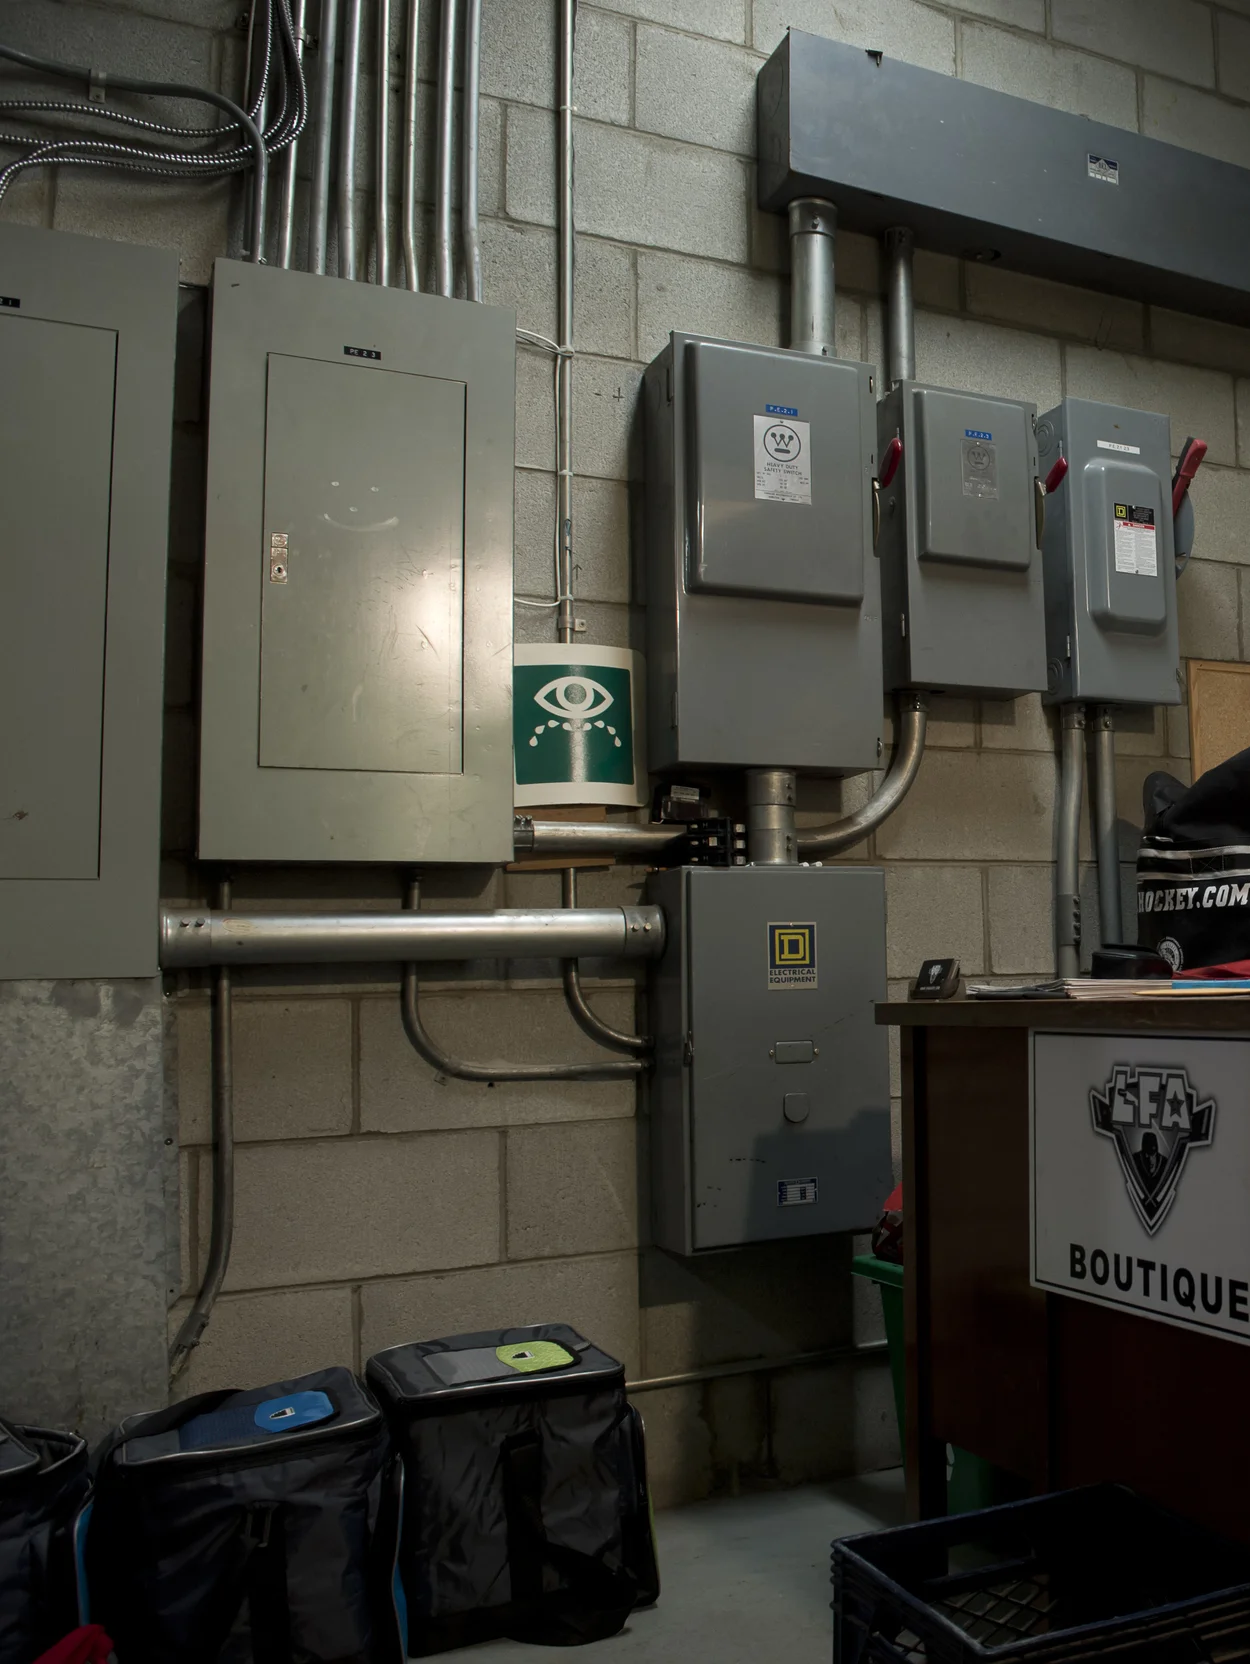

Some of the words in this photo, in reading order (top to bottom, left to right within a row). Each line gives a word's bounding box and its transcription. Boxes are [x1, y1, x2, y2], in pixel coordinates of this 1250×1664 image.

[769, 968, 816, 976] ELECTRICAL
[769, 976, 816, 984] EQUIPMENT
[1112, 1072, 1191, 1128] LFA
[1070, 1243, 1249, 1322] BOUTIQUE
